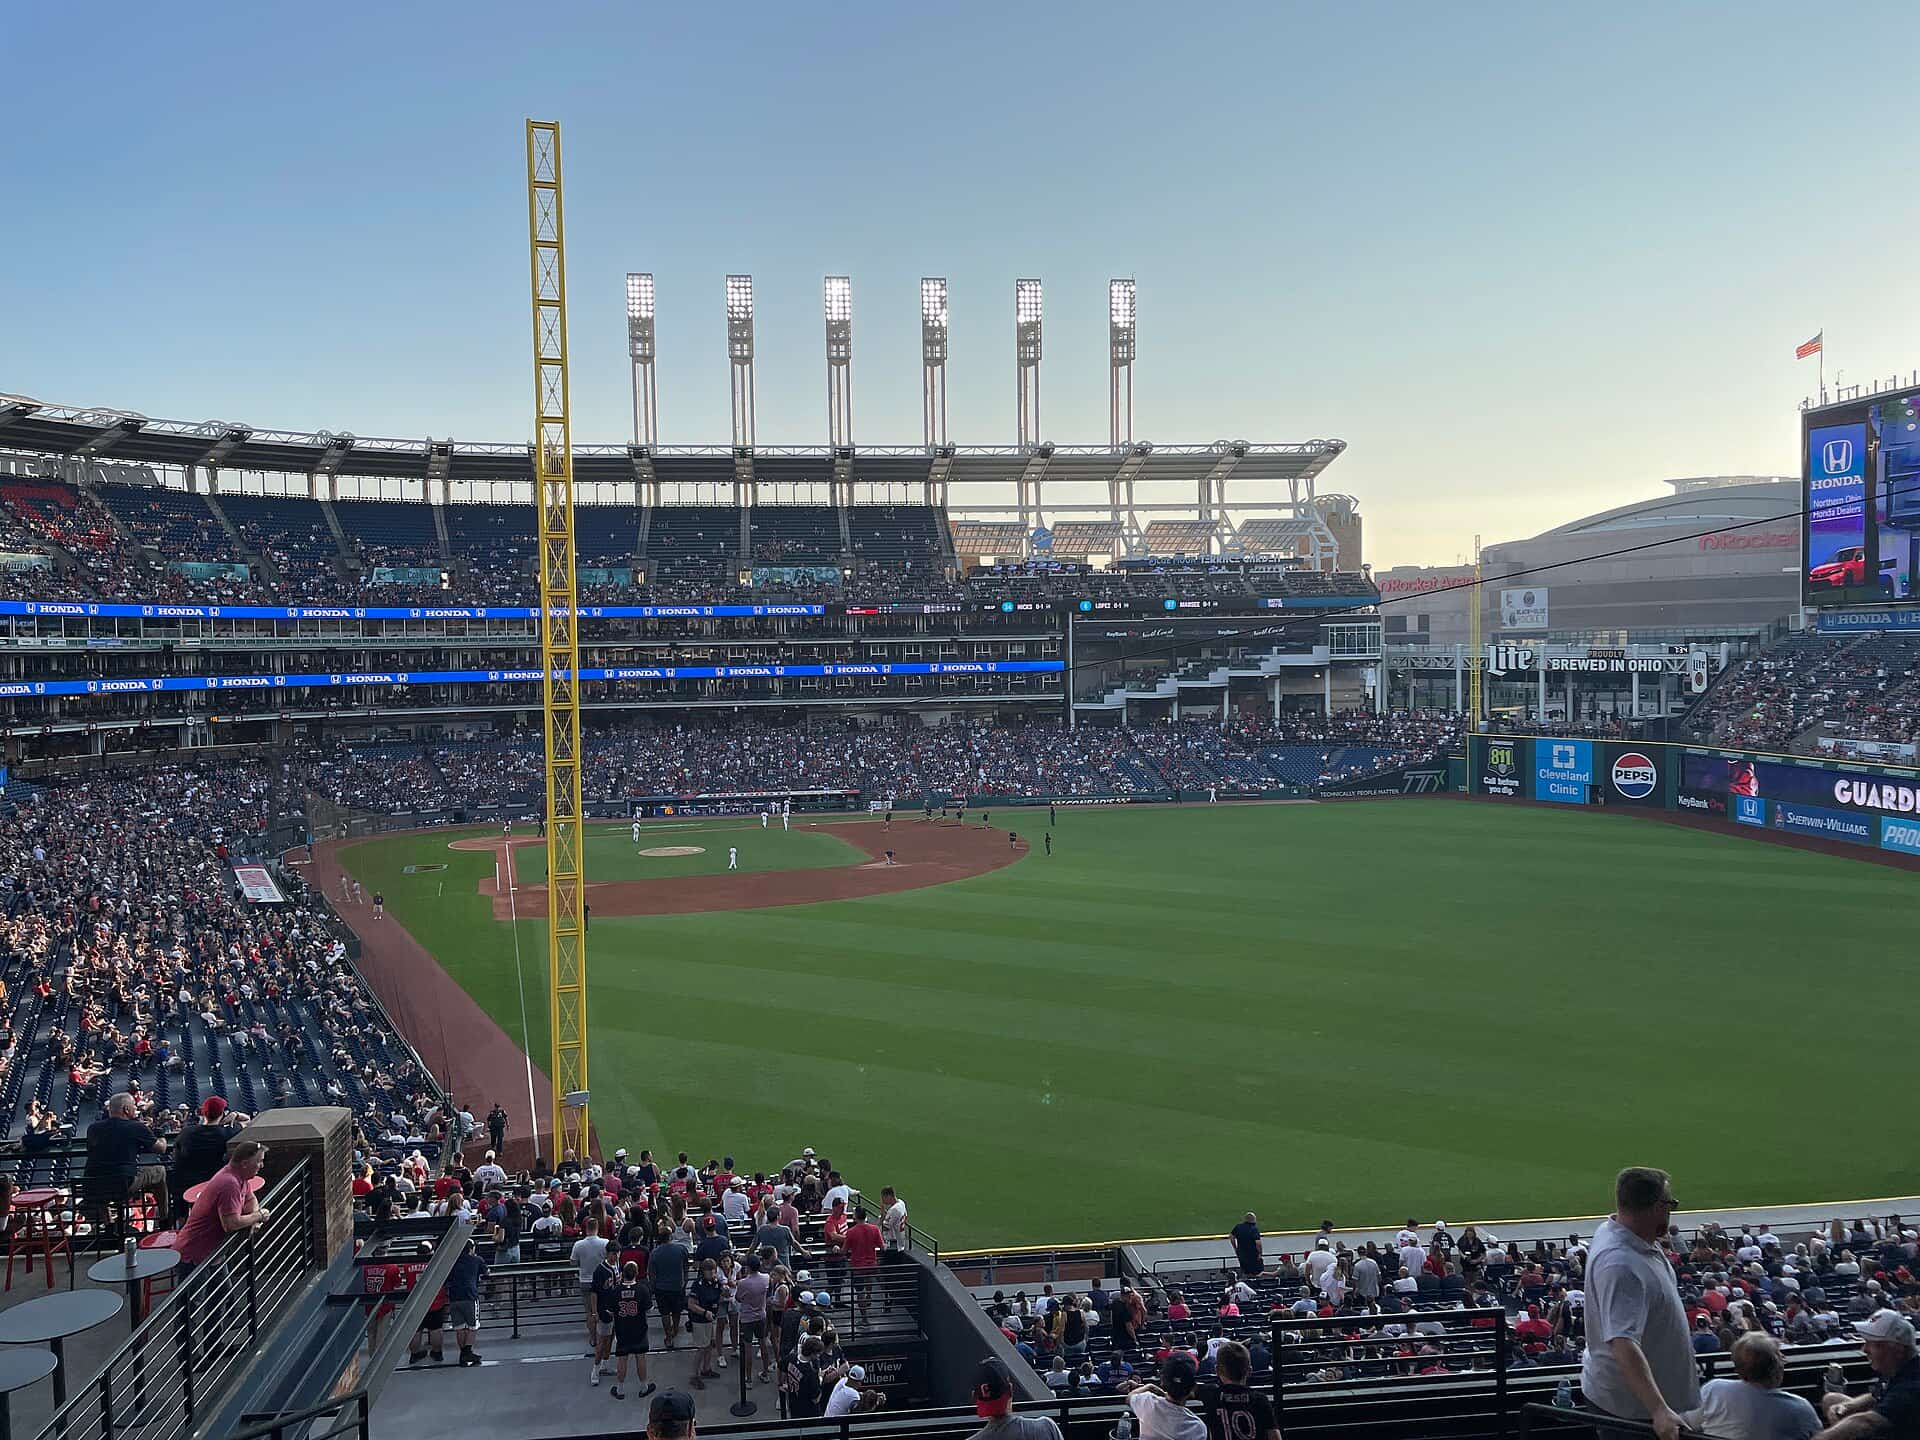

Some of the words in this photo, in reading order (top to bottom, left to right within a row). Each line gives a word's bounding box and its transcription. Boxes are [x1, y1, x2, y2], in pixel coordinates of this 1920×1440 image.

[1811, 475, 1864, 490] HONDA
[1813, 497, 1843, 507] Northern
[1813, 509, 1835, 519] Honda
[1838, 506, 1861, 515] Dealers
[1393, 576, 1438, 591] Rocket
[40, 605, 84, 614] HONDA
[158, 607, 204, 616] HONDA
[302, 609, 350, 617] HONDA
[425, 609, 471, 617] HONDA
[1837, 613, 1892, 625] HONDA
[1588, 649, 1624, 658] PROUDLY
[1487, 645, 1532, 676] Lite
[1552, 659, 1606, 671] BREWED
[1610, 659, 1625, 671] IN
[1628, 659, 1662, 672] OHIO
[222, 678, 269, 686] HONDA
[346, 675, 392, 683] HONDA
[101, 681, 148, 690] HONDA
[1491, 748, 1511, 766] 811
[1539, 769, 1589, 782] Cleveland
[1615, 770, 1653, 781] PEPSI
[1403, 770, 1446, 793] TTX
[1483, 777, 1496, 785] Call
[1497, 778, 1520, 787] before
[1489, 786, 1501, 794] you
[1549, 783, 1578, 795] Clinic
[1678, 795, 1708, 809] KeyBank
[876, 1362, 902, 1372] View
[1216, 1408, 1257, 1440] 10
